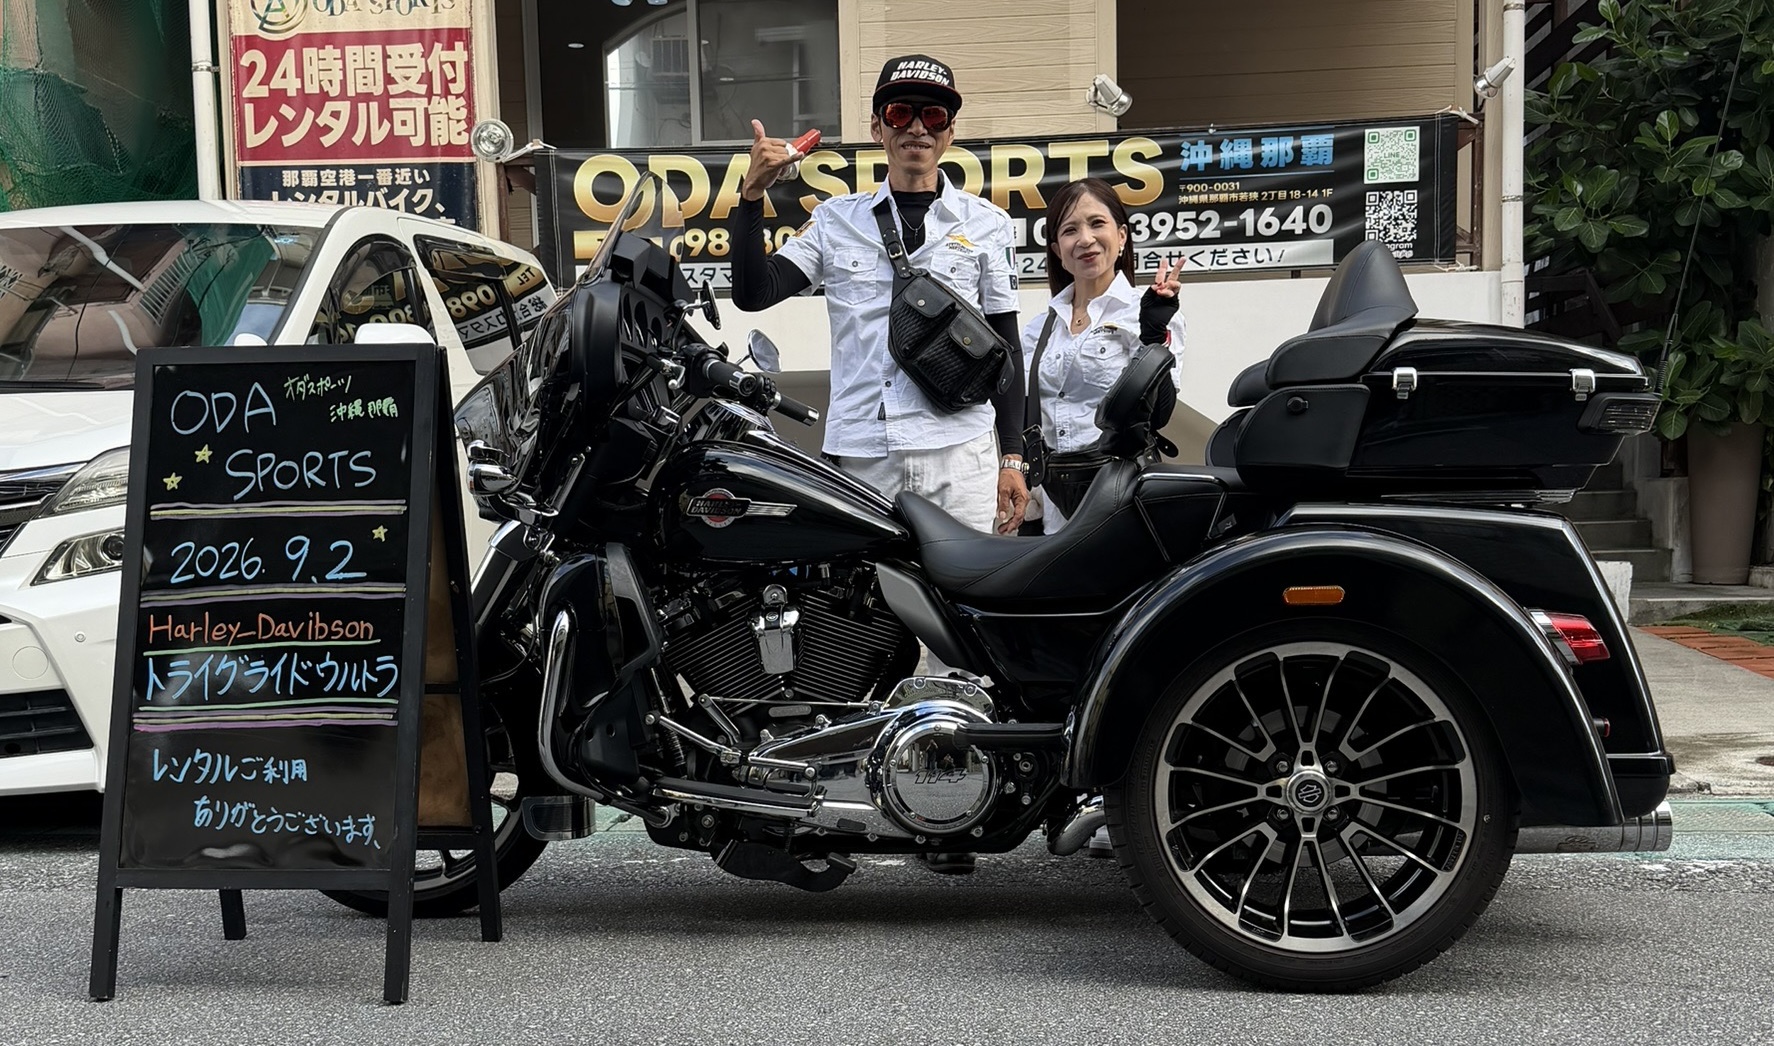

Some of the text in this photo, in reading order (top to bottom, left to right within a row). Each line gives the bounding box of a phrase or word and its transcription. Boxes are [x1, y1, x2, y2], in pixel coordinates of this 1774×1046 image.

[239, 41, 468, 98] 24時間受付
[890, 69, 950, 86] DAVIDSON
[244, 95, 470, 149] レンタル可能
[1179, 133, 1335, 172] 沖縄那覇
[281, 168, 431, 188] 那覇空港一番近い
[283, 373, 352, 401] オダスポーツ
[170, 381, 277, 436] ODA
[225, 449, 377, 502] SPORTS
[146, 651, 399, 701] トライグライドウルトラ
[153, 748, 308, 785] レンタルご利用
[914, 768, 968, 785] 114
